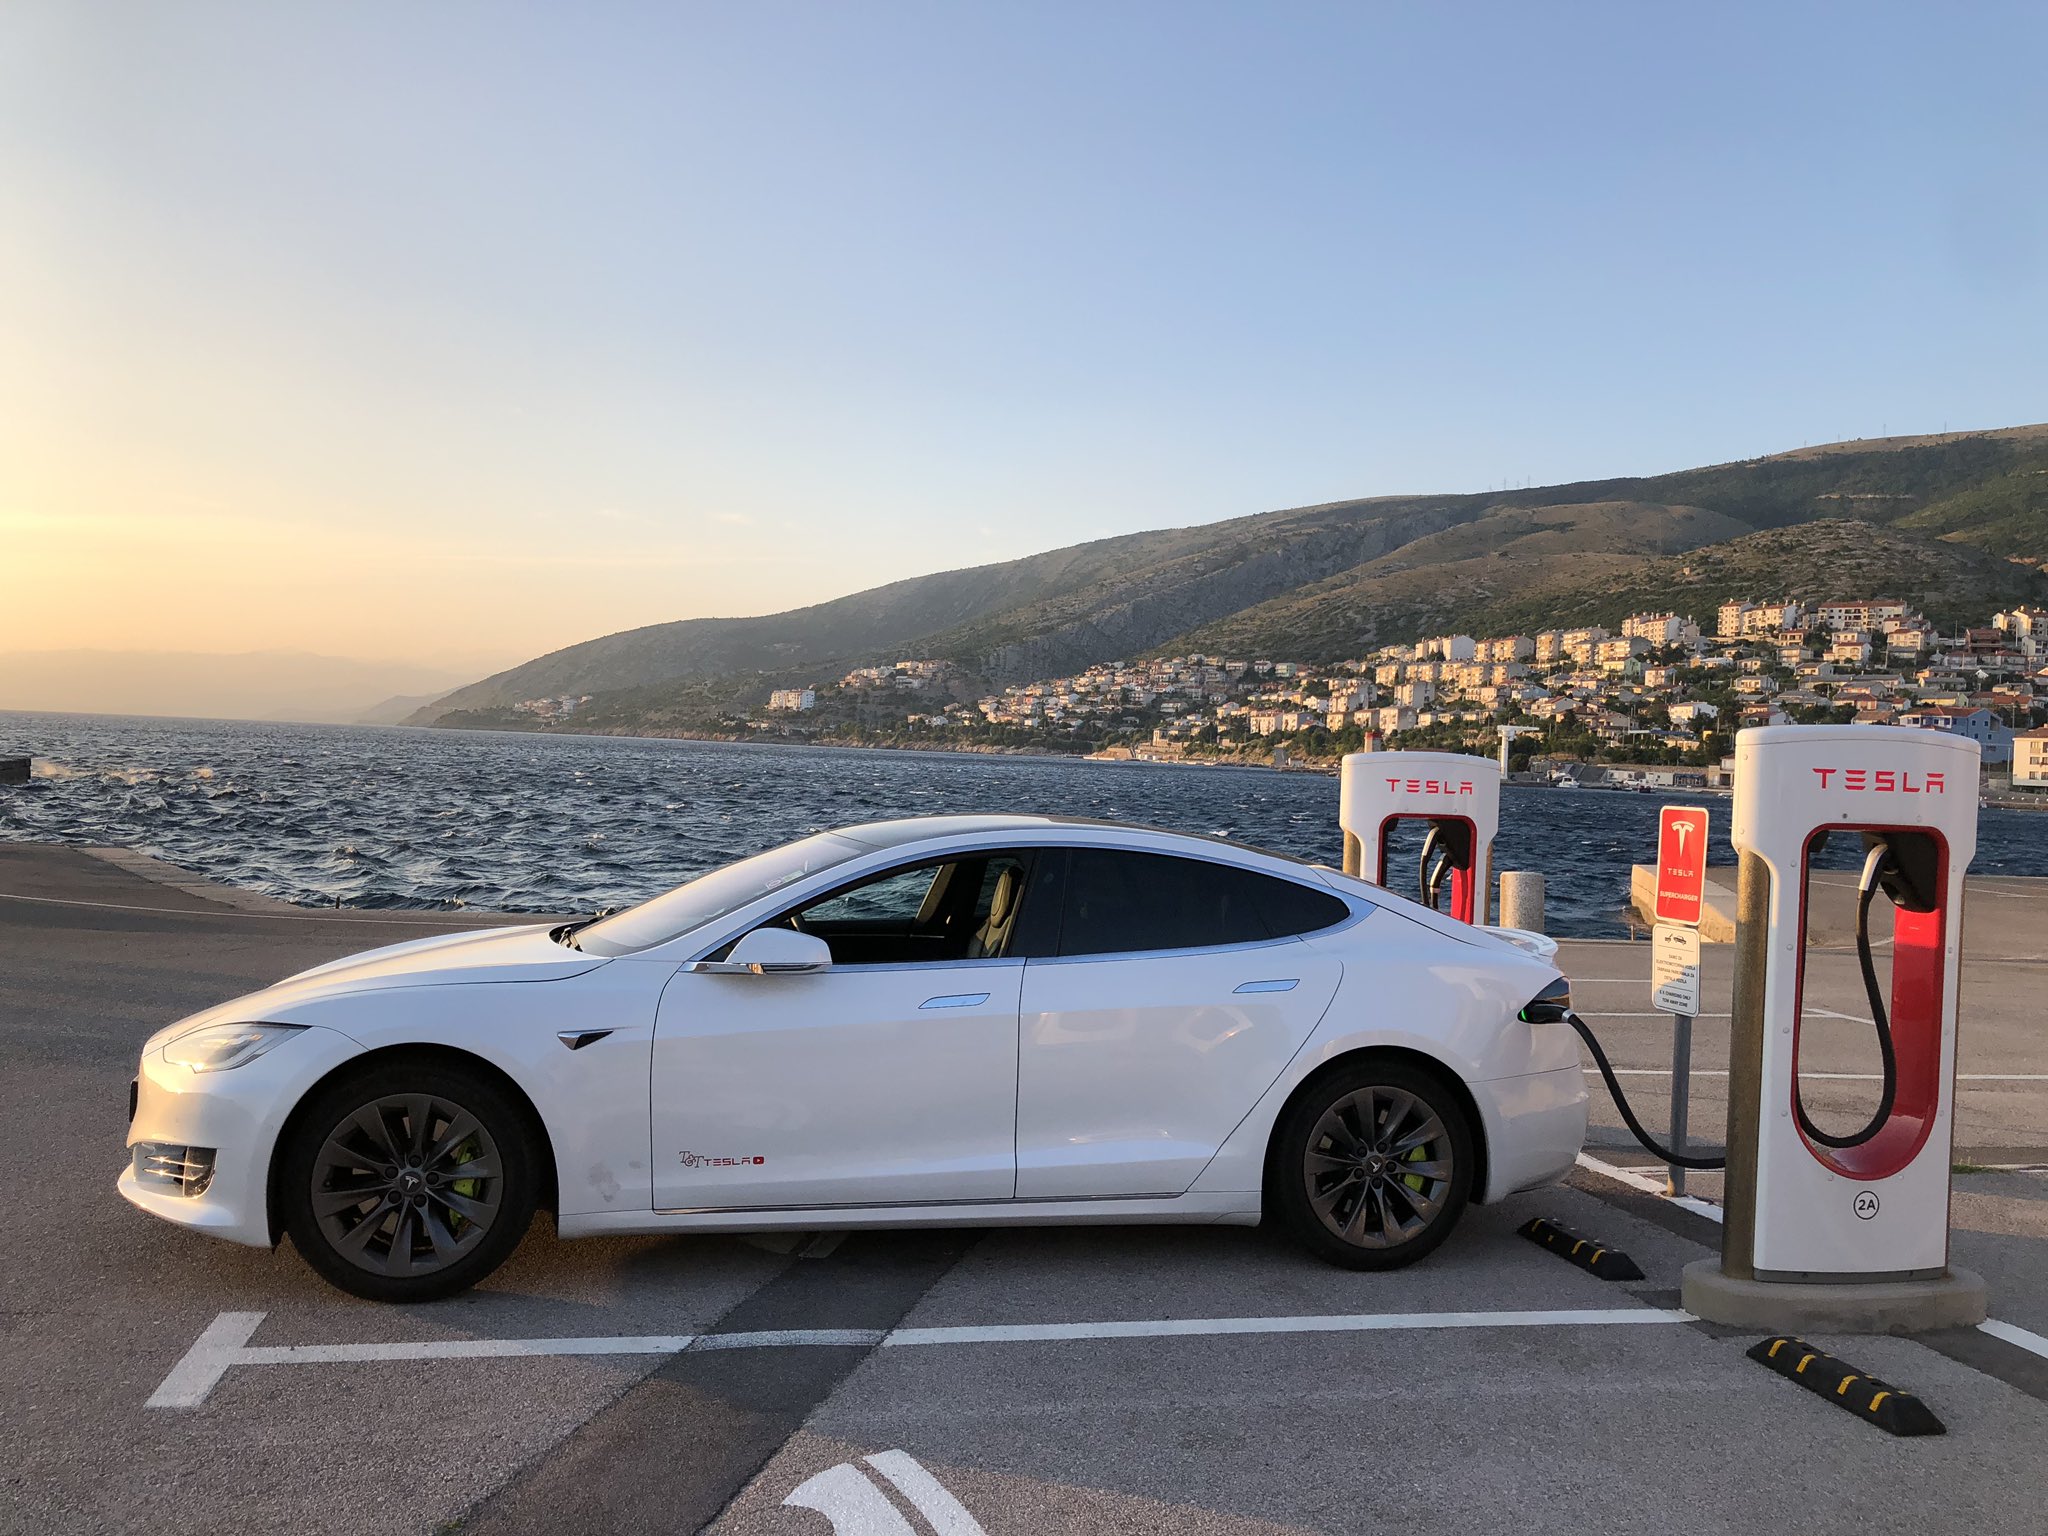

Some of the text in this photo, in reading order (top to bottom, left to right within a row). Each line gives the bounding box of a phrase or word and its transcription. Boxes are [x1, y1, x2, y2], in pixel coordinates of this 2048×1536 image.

[1385, 778, 1473, 795] TESLA
[1812, 768, 1944, 794] TESLA
[1667, 867, 1694, 877] TESLA
[1659, 890, 1699, 902] SUPERCHARGER
[704, 1157, 751, 1167] TESLA
[1858, 1199, 1876, 1211] 2A
